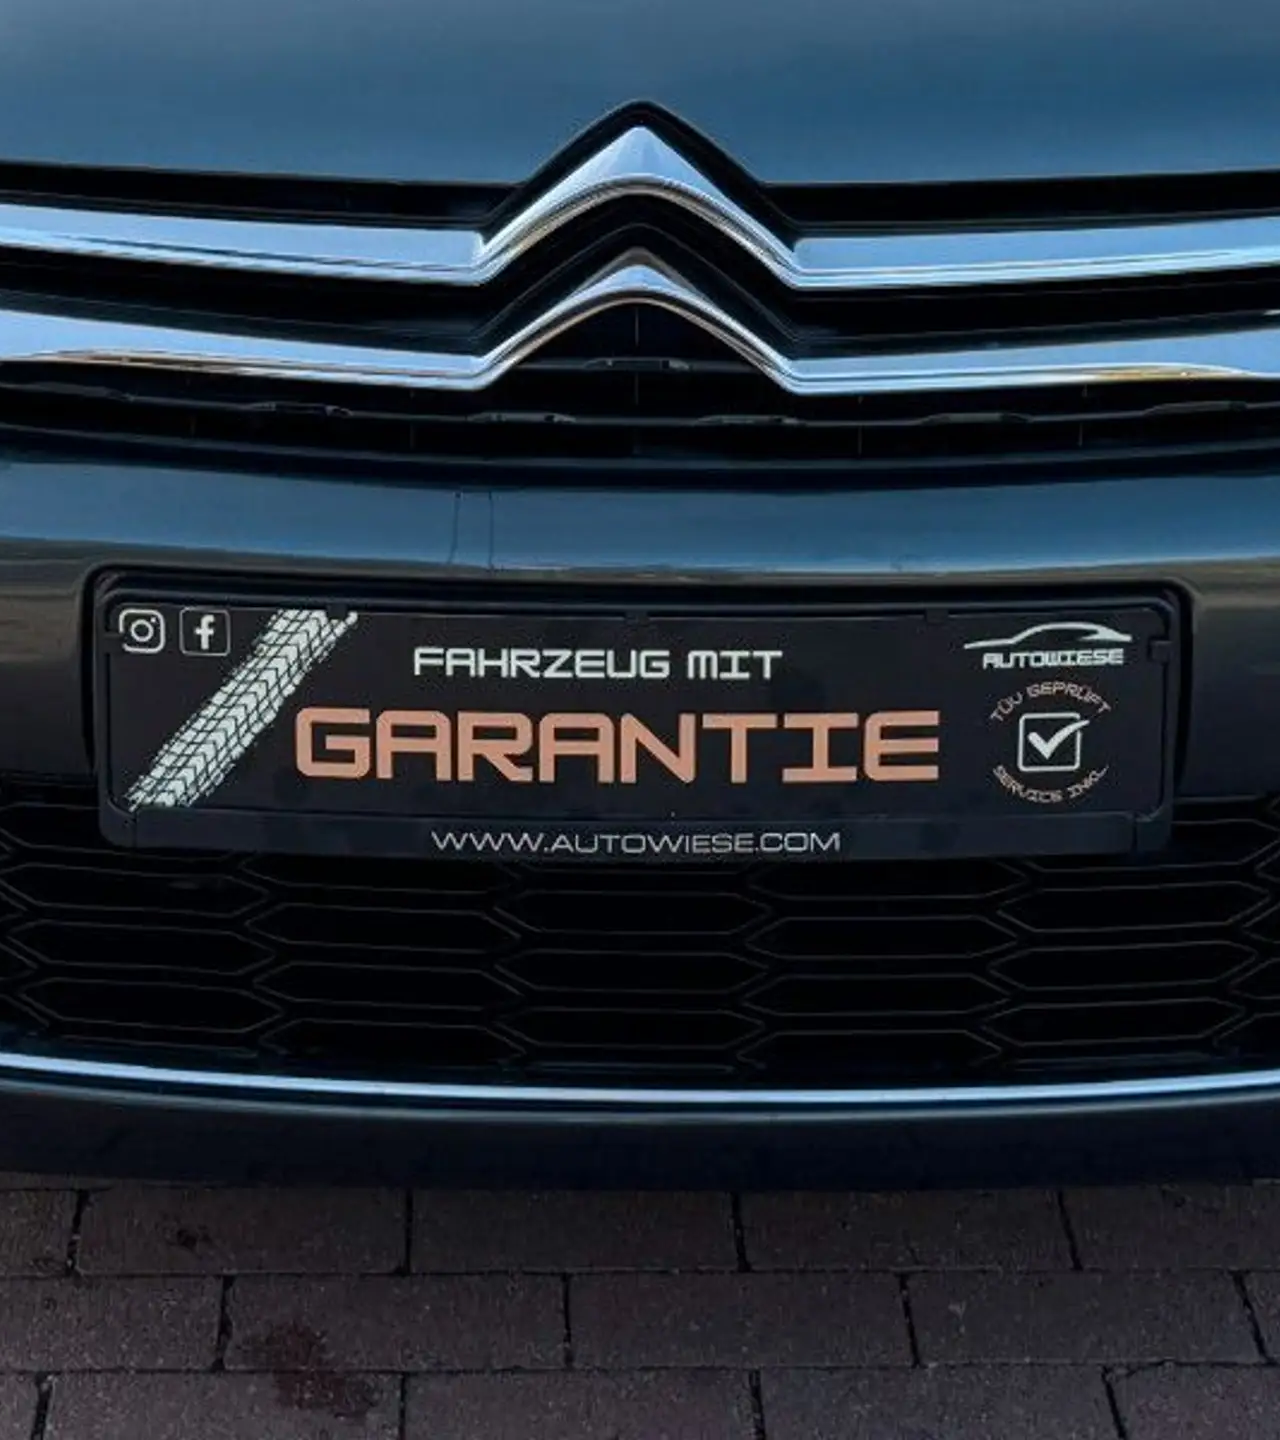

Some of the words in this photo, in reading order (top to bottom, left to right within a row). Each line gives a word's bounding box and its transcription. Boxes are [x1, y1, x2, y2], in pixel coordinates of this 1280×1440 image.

[413, 647, 670, 679] FAHRZEUG
[687, 650, 783, 680] MIT
[982, 648, 1125, 670] AUTOWIESE
[293, 708, 941, 785] GARANTIE
[992, 764, 1064, 803] SERVICE
[431, 830, 842, 854] WWW.AUTOWIESE.COM
